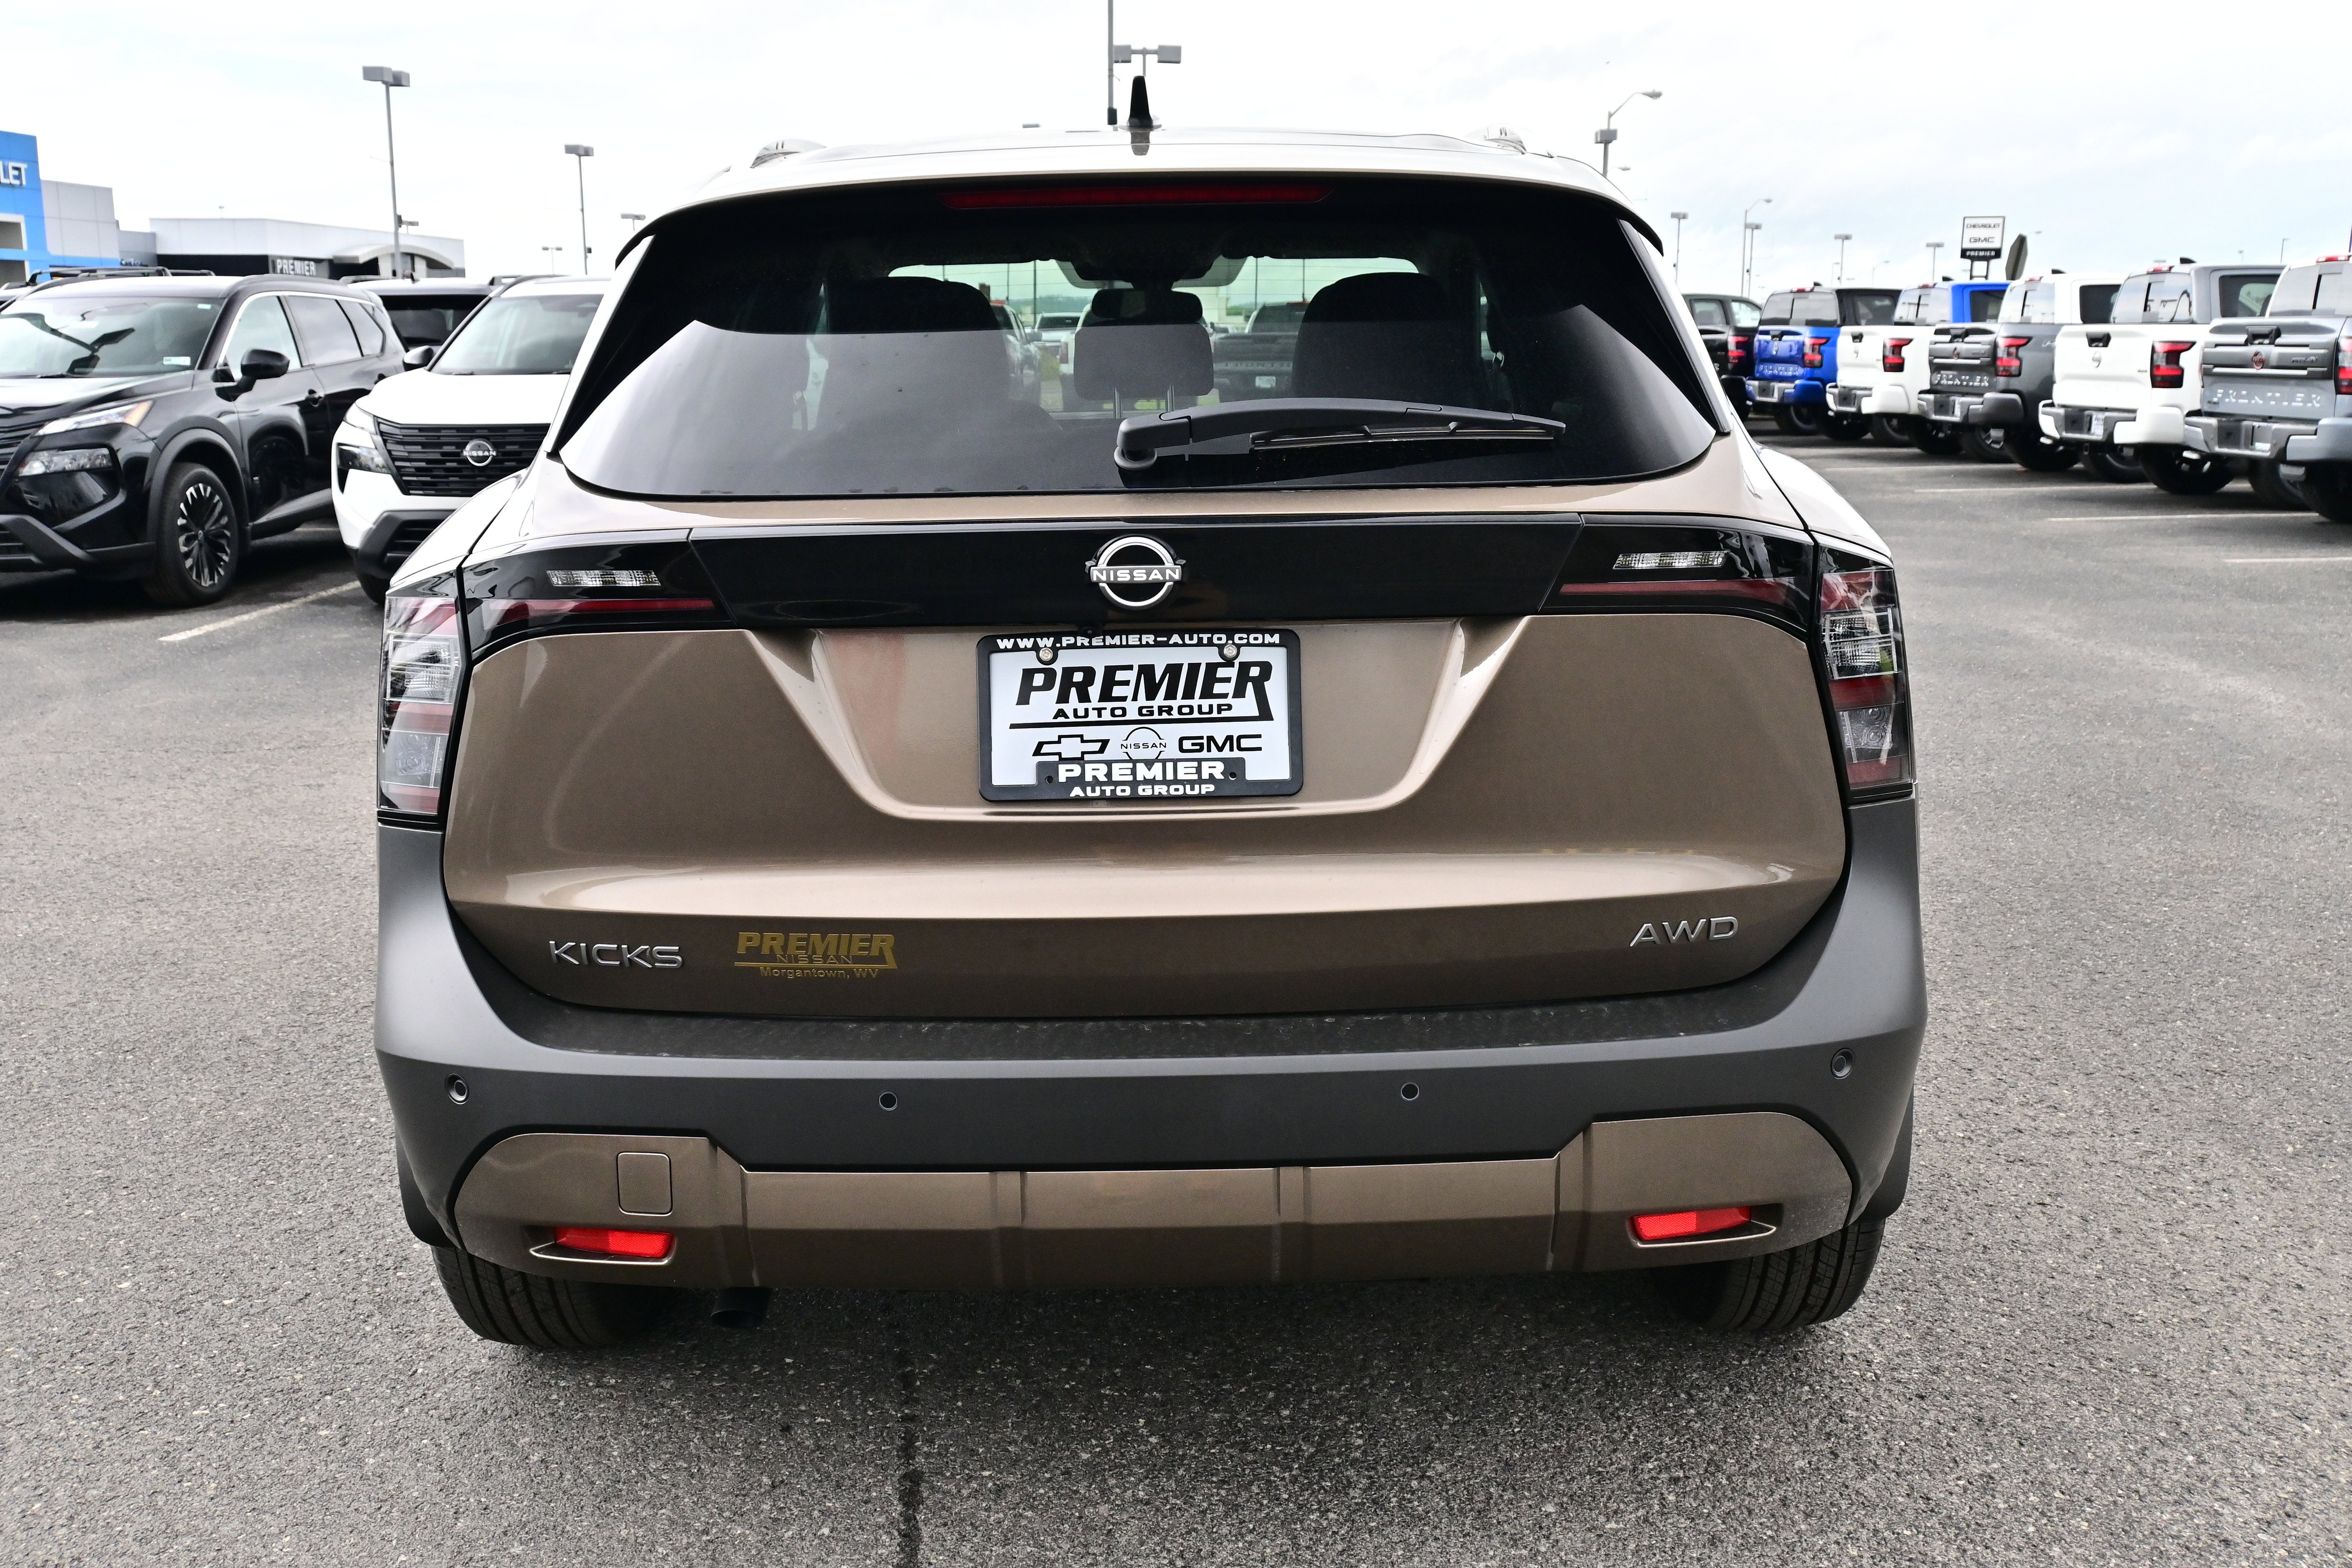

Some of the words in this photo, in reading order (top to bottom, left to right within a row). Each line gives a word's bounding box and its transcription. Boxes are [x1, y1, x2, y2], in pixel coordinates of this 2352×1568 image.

[277, 259, 317, 277] PREMIER
[1093, 569, 1179, 581] NISSAN
[996, 634, 1280, 649] WWW.PREMIER-AUTO.COM
[1015, 661, 1274, 721] PREMIER
[1052, 708, 1127, 720] AUTO
[1138, 703, 1233, 717] GROUP
[1121, 741, 1167, 749] NISSAN
[1178, 734, 1262, 753] GMC
[1058, 761, 1225, 782] PREMIER
[1069, 785, 1131, 797] AUTO
[1138, 784, 1215, 796] GROUP
[1630, 916, 1739, 947] AWD
[549, 941, 683, 969] KICKS
[737, 932, 897, 968] PREMIER
[776, 955, 853, 964] NISSAN
[760, 967, 849, 979] Morgantown,
[853, 969, 879, 978] WV
